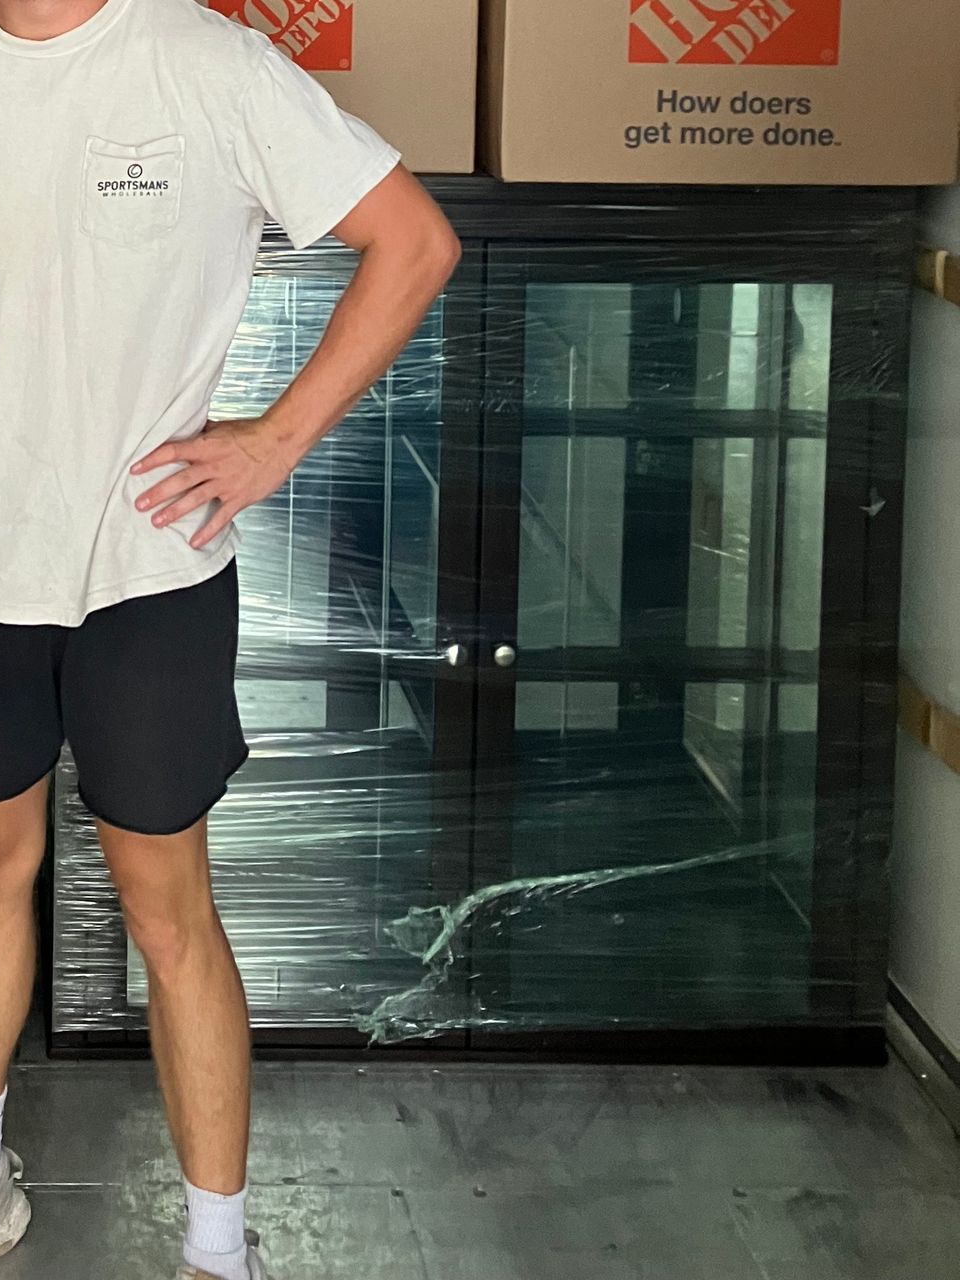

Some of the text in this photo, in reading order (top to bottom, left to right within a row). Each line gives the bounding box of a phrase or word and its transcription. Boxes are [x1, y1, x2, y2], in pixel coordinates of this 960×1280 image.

[656, 89, 811, 115] How doers
[624, 122, 672, 148] get
[680, 126, 754, 145] more
[97, 180, 169, 191] SPORTSMANS
